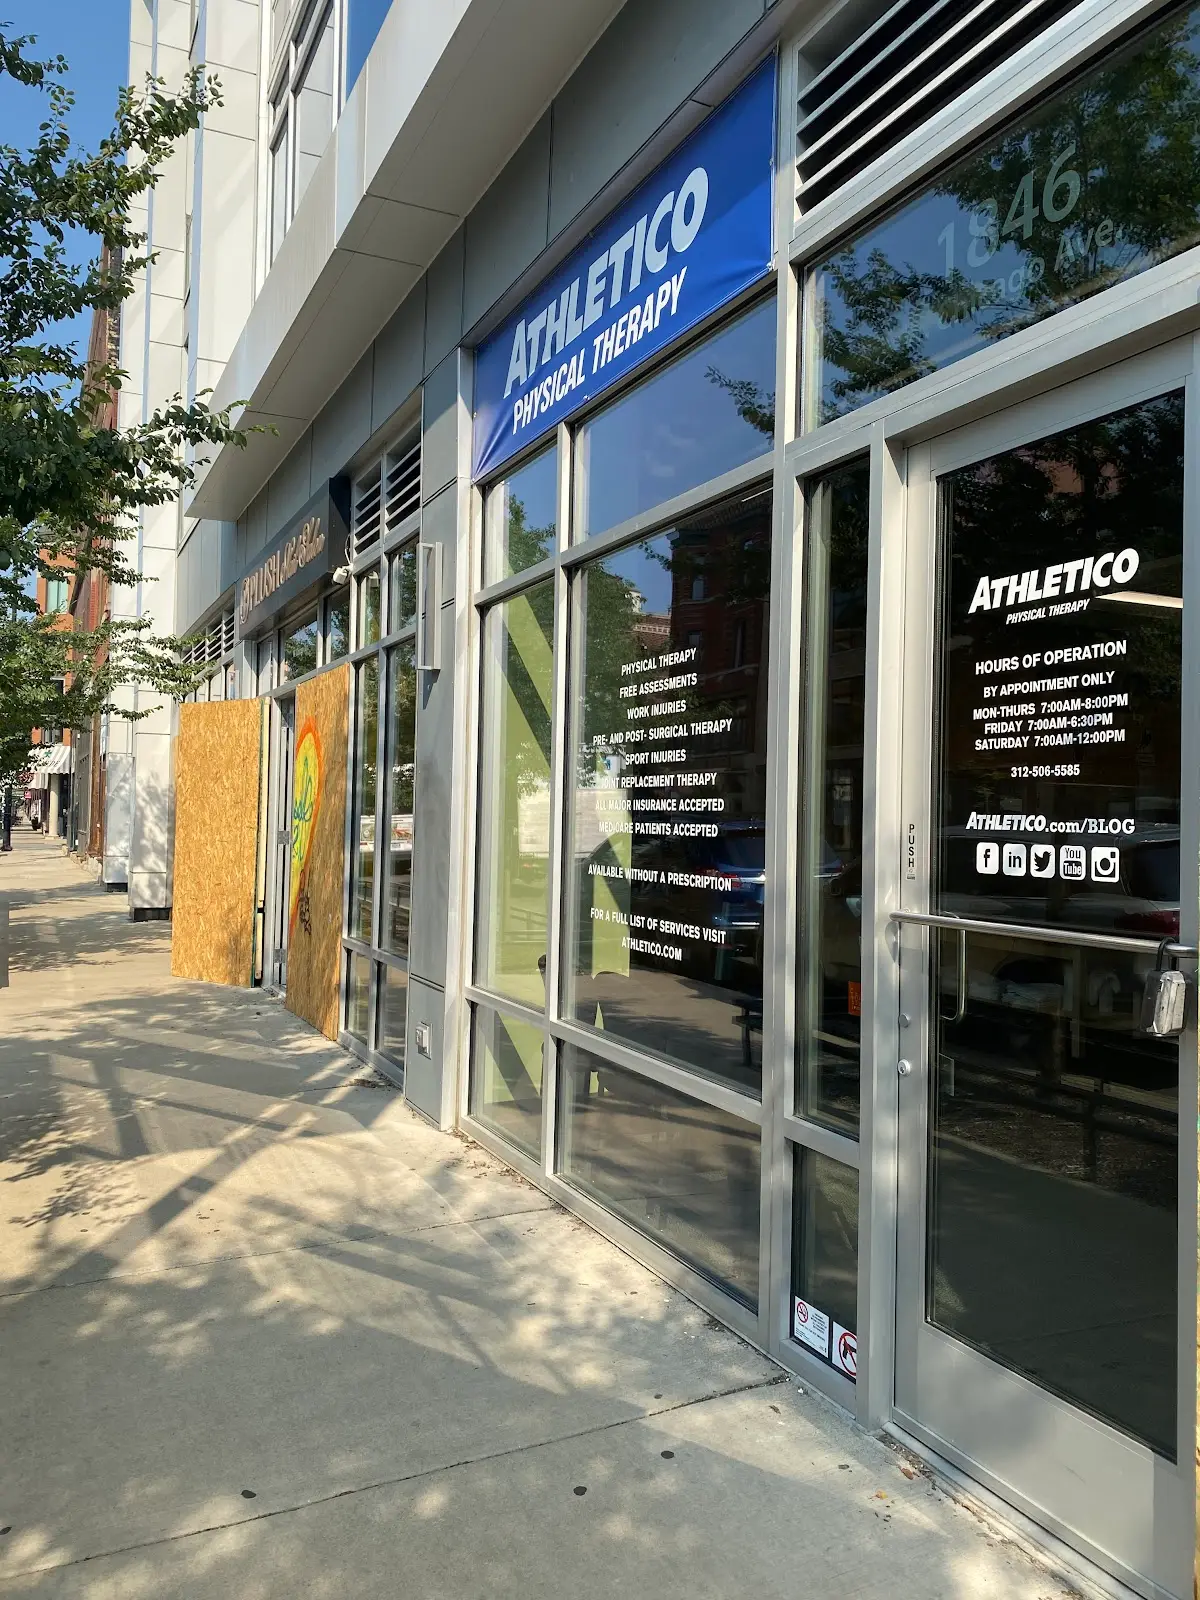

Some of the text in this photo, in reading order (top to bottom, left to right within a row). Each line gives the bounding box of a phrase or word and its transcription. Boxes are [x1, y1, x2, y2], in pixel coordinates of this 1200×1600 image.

[937, 140, 1081, 277] 1846
[503, 166, 709, 400] ATHLETICO
[512, 266, 687, 435] PHYSICAL THERAPY
[968, 547, 1140, 614] ATHLETICO
[1005, 598, 1090, 625] PHYSICAL THERAPY
[621, 647, 697, 676] PHYSICAL THERAPY
[975, 639, 1127, 675] HOURS OF OPERATION
[619, 673, 698, 698] FREE ASSESSMENTS
[983, 670, 1115, 698] BY APPOINTMENT ONLY
[627, 699, 687, 720] WORK INJURIES
[972, 693, 1129, 721] MON-THURS 7:00AM-8:00PM
[593, 718, 733, 746] PRE- AND POST- SURGICAL THERAPY
[984, 712, 1113, 735] FRIDAY 7:00AM-6:30PM
[975, 728, 1126, 751] SATURDAY 7:00AM-12:00PM
[625, 749, 687, 766] SPORT INJURIES
[621, 774, 675, 788] REPLACEMENT
[676, 772, 718, 787] THERAPY
[1010, 764, 1080, 778] 312-506-5585
[595, 798, 725, 812] ALL MAJOR INSURANCE ACCEPTED
[635, 823, 671, 836] PATIENTS
[672, 824, 719, 837] ACCEPTED
[1064, 847, 1081, 859] You
[588, 864, 732, 892] AVAILABLE WITHOUT A PRESCRIPTION
[1063, 861, 1082, 876] Tube
[590, 908, 727, 944] FOR A FULL LIST OF SERVICES VISIT
[621, 937, 682, 961] ATHLETICO.COM
